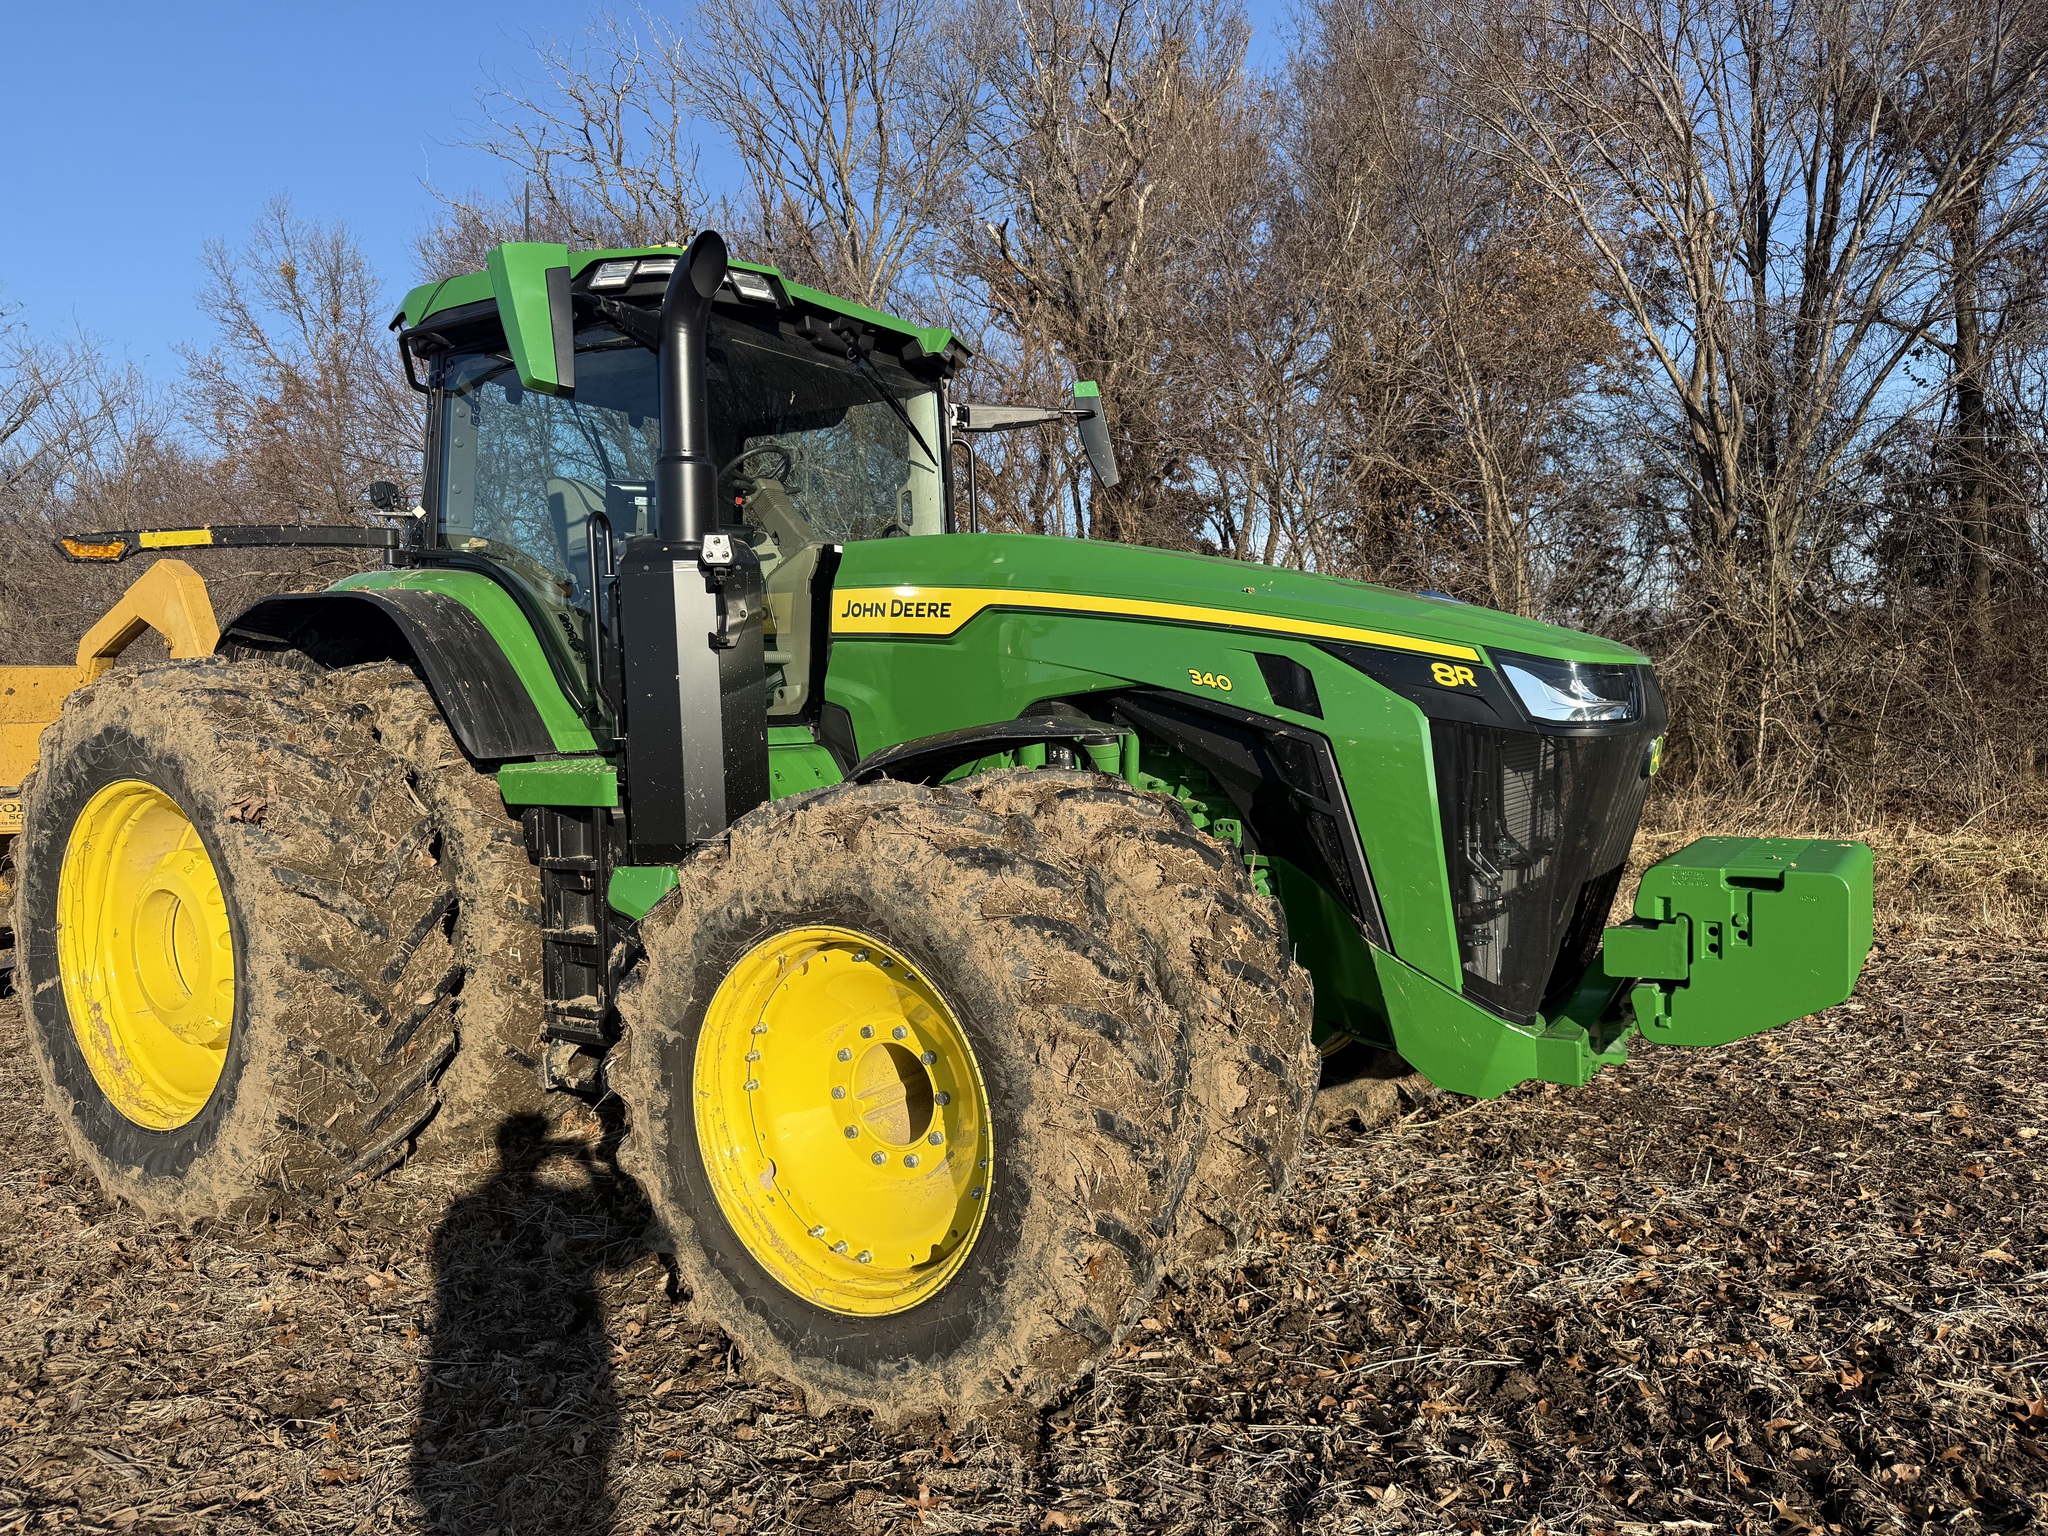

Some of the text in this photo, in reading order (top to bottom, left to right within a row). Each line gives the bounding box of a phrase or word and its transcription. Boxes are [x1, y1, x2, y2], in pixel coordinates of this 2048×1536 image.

[841, 599, 952, 618] JOHN DEERE
[1187, 669, 1233, 692] 340
[1431, 662, 1478, 688] 8R
